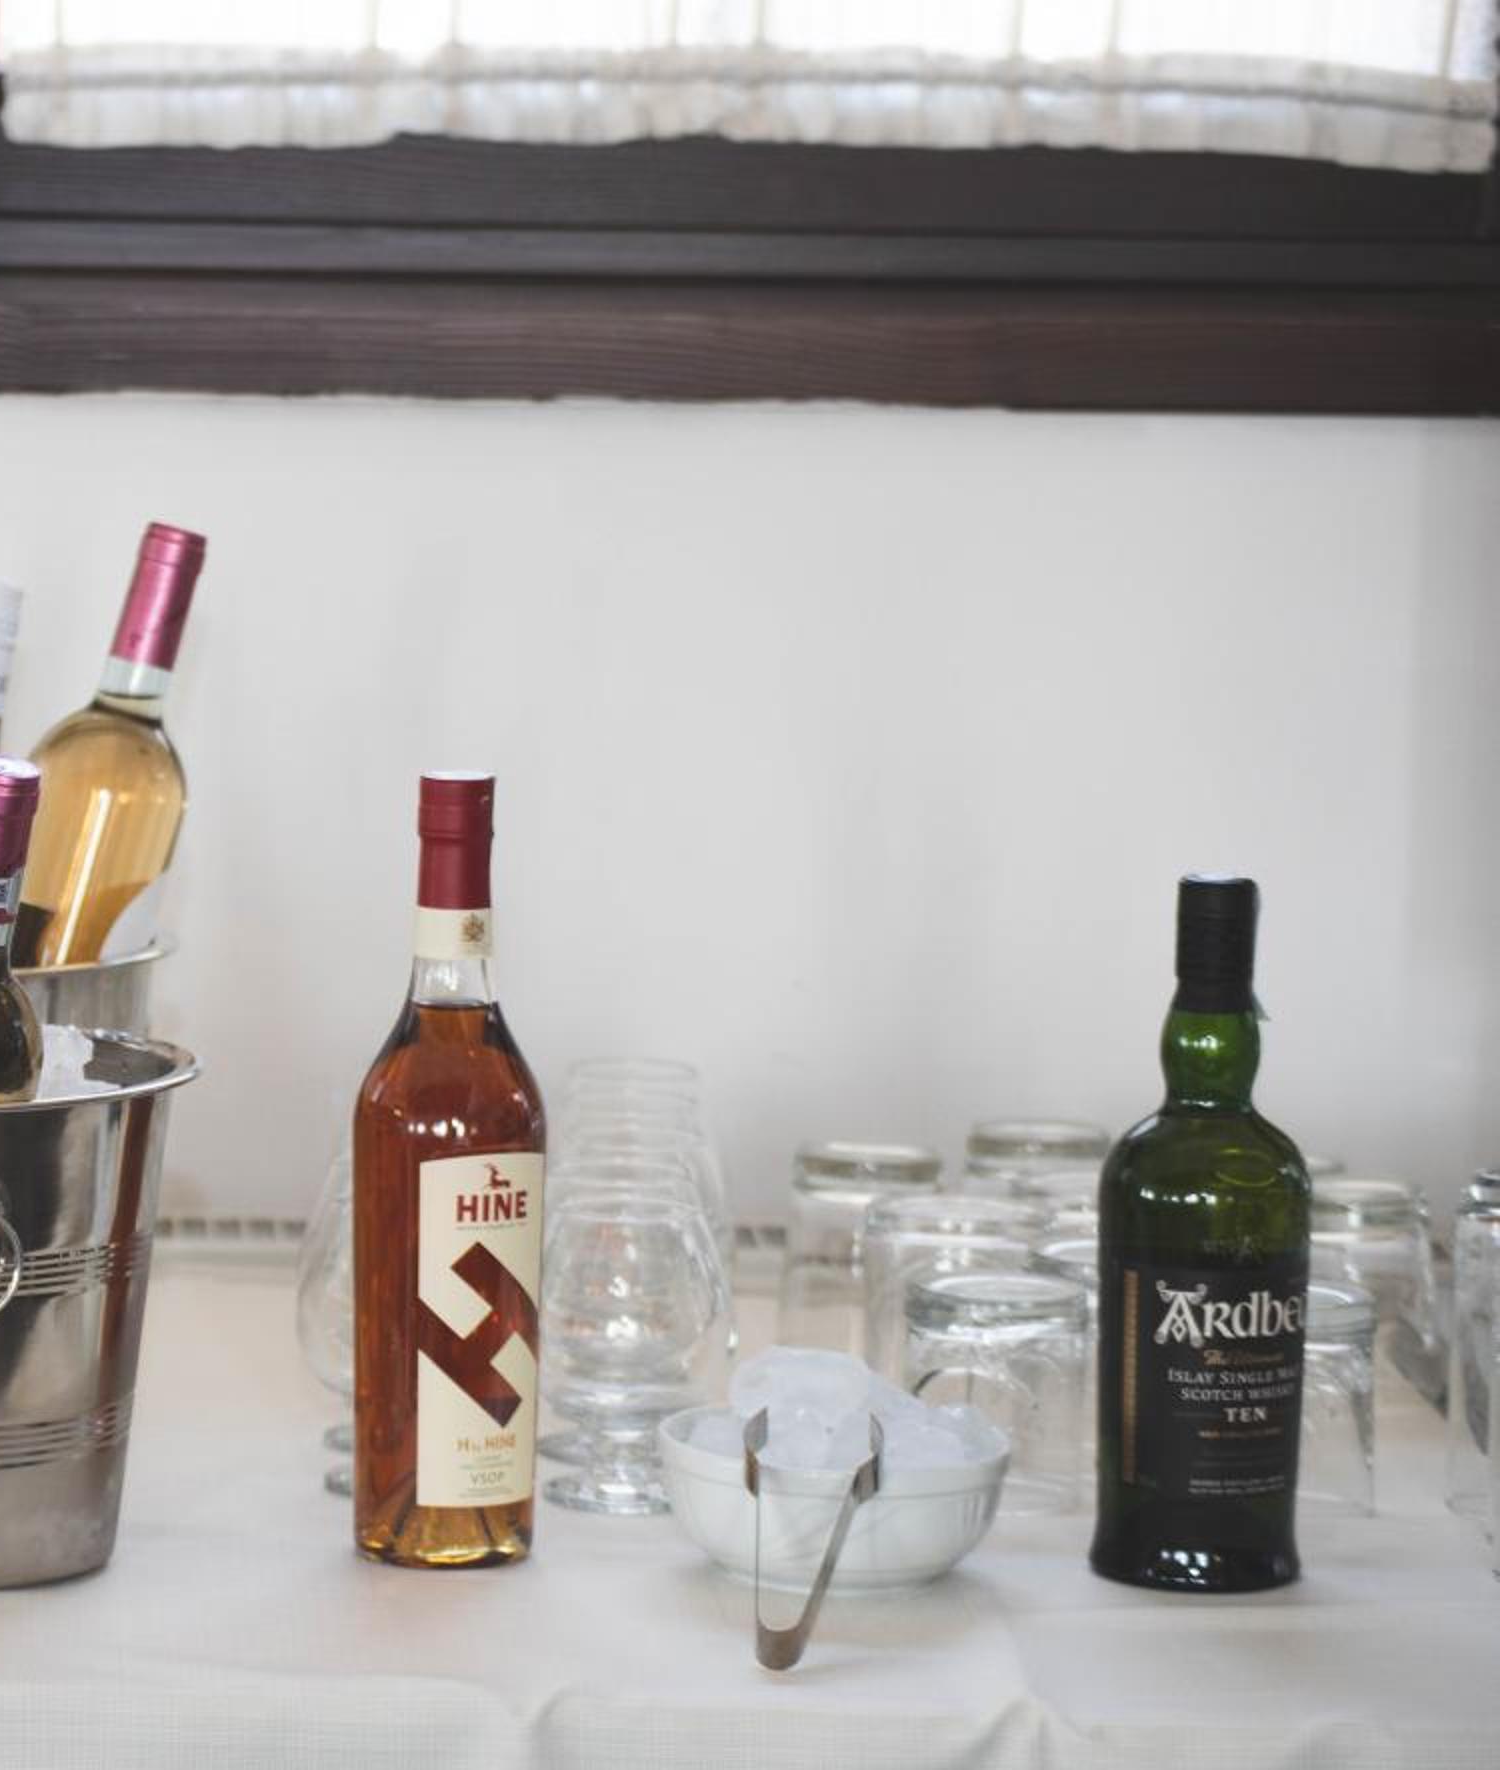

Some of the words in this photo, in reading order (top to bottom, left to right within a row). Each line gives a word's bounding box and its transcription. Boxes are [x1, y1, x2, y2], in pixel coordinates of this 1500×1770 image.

[456, 1190, 528, 1222] HINE
[1153, 1279, 1301, 1348] Ardbe
[1180, 1386, 1244, 1402] SCOTCH
[1223, 1406, 1268, 1423] TEN
